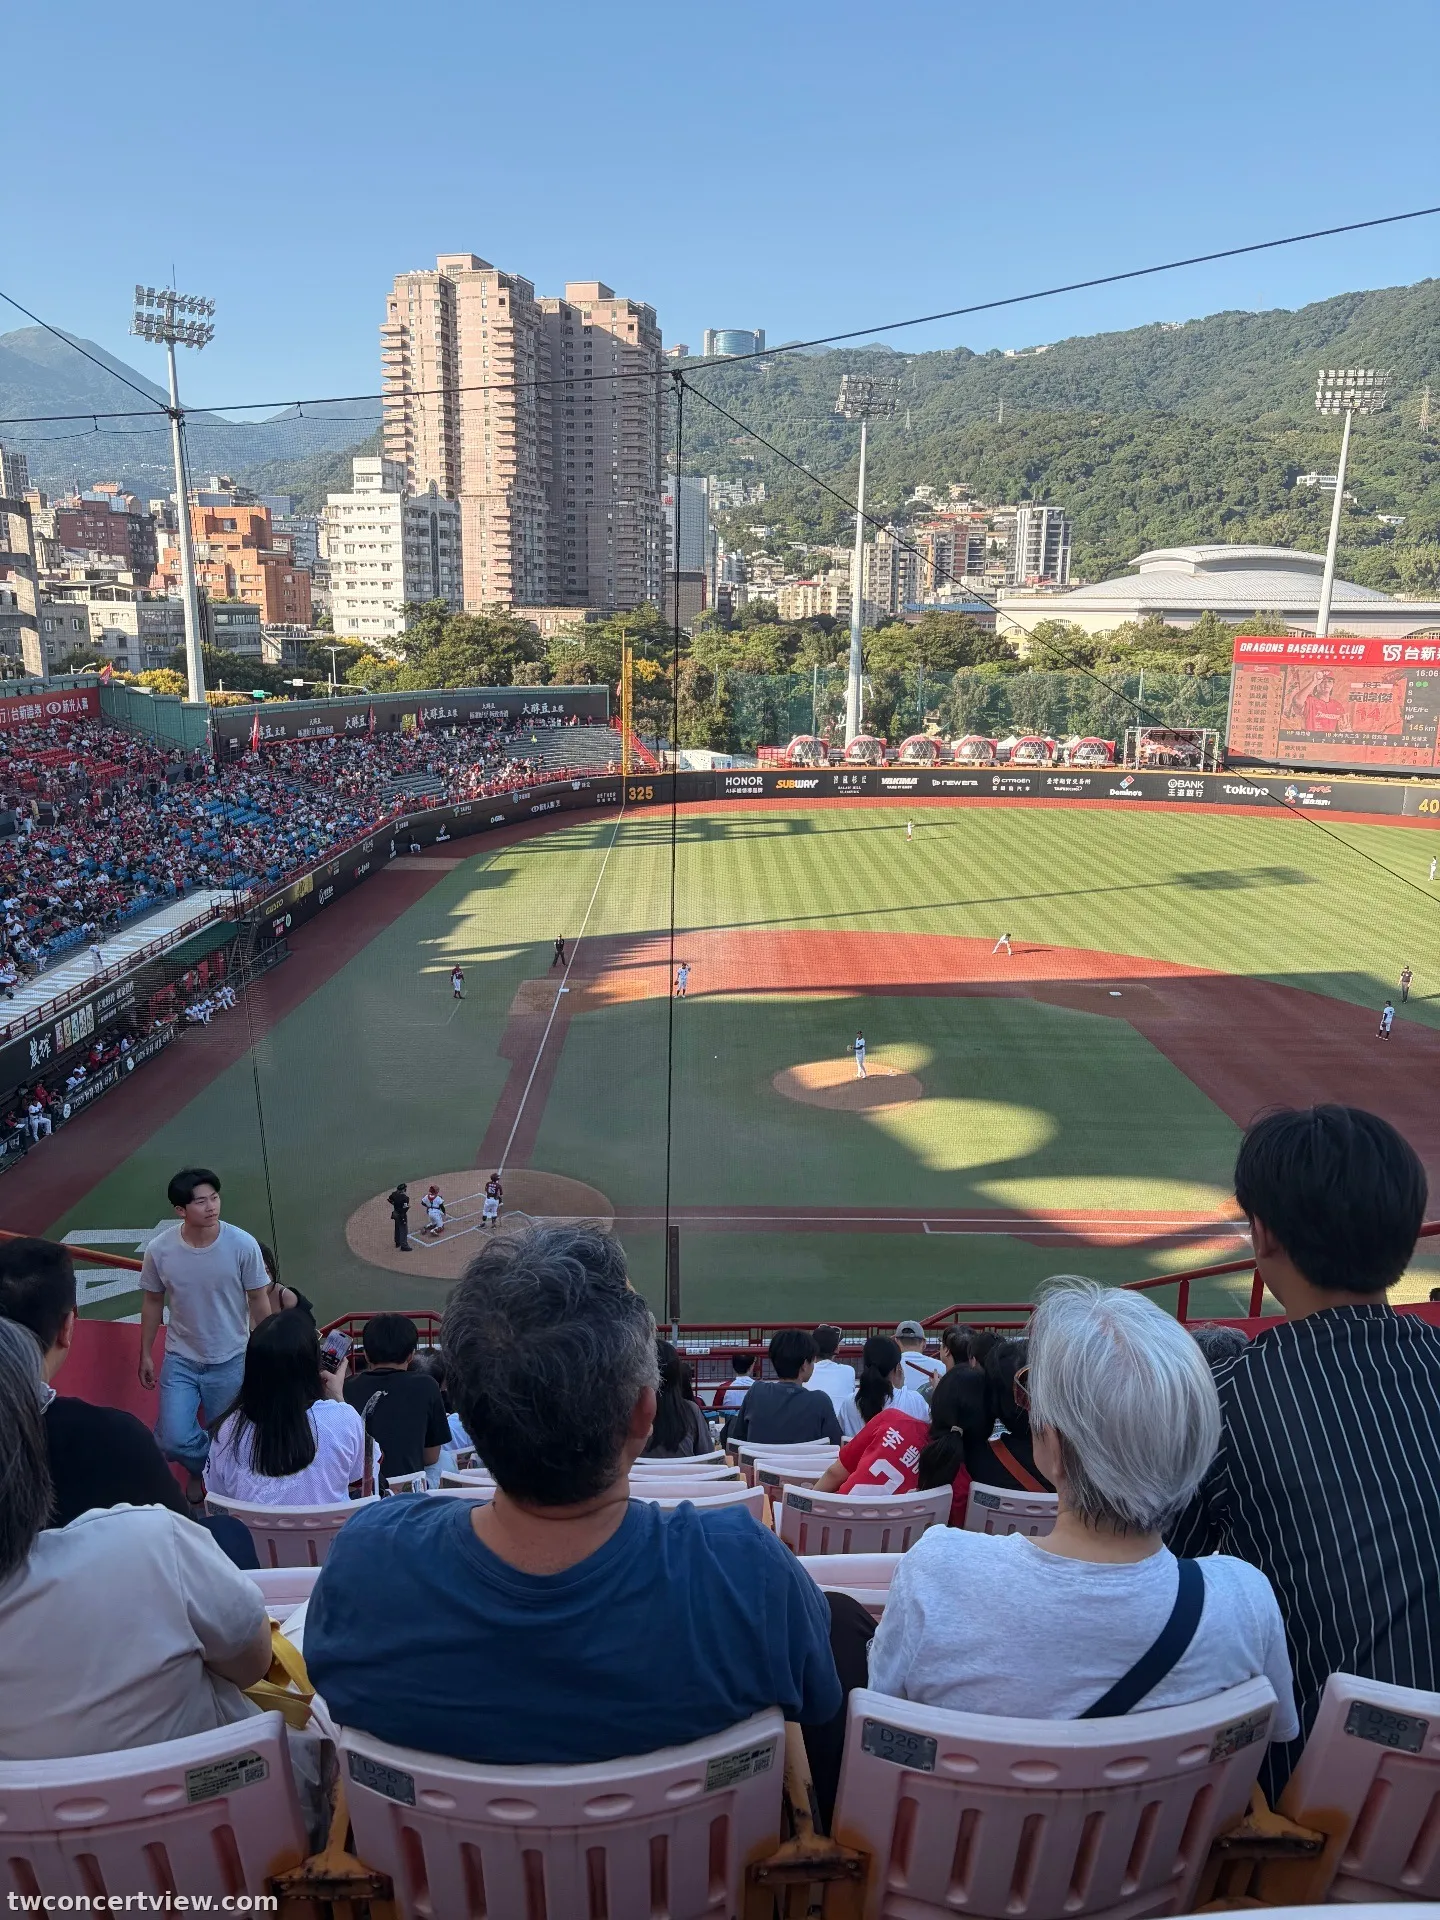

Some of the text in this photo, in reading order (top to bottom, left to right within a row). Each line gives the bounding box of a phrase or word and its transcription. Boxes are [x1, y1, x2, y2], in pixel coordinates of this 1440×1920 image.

[1240, 642, 1366, 655] DRAGONS BASEBALL CLUB
[1416, 669, 1439, 677] 16:06
[62, 697, 89, 714] 新光人壽
[1356, 707, 1380, 721] 14
[725, 776, 764, 786] HONOR
[776, 779, 818, 789] SUBWAY
[881, 777, 918, 785] YAKIMA
[1046, 777, 1091, 785] 臺灣期貨交易所
[628, 785, 654, 801] 325
[1109, 788, 1142, 797] Domino's
[1168, 789, 1204, 798] 王道銀行
[1225, 784, 1269, 797] tokuyo
[1418, 798, 1440, 814] 40
[1368, 1710, 1410, 1732] D26
[880, 1728, 918, 1750] D26
[363, 1761, 398, 1783] D26
